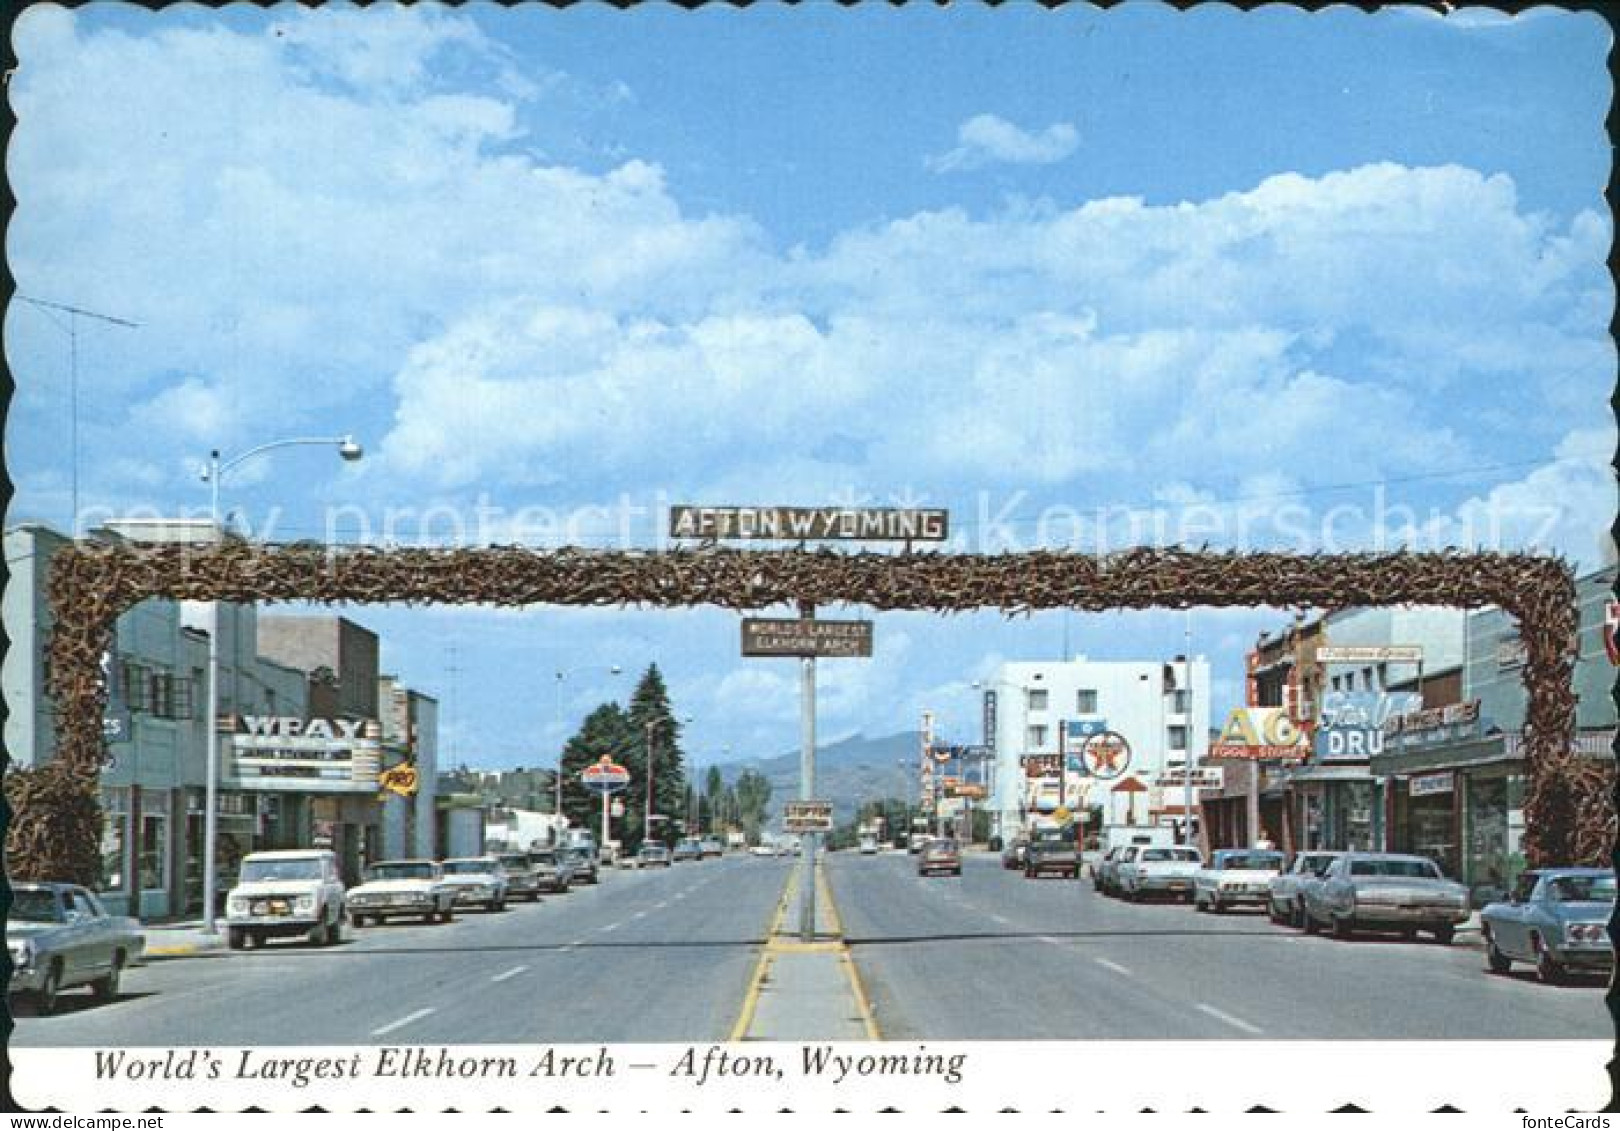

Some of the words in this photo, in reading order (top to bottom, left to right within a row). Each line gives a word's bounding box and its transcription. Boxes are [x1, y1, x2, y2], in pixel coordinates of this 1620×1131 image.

[675, 509, 779, 537] AFTON
[789, 509, 943, 538] WYOMING
[756, 635, 817, 649] ELKHORN
[1328, 730, 1385, 753] DRU
